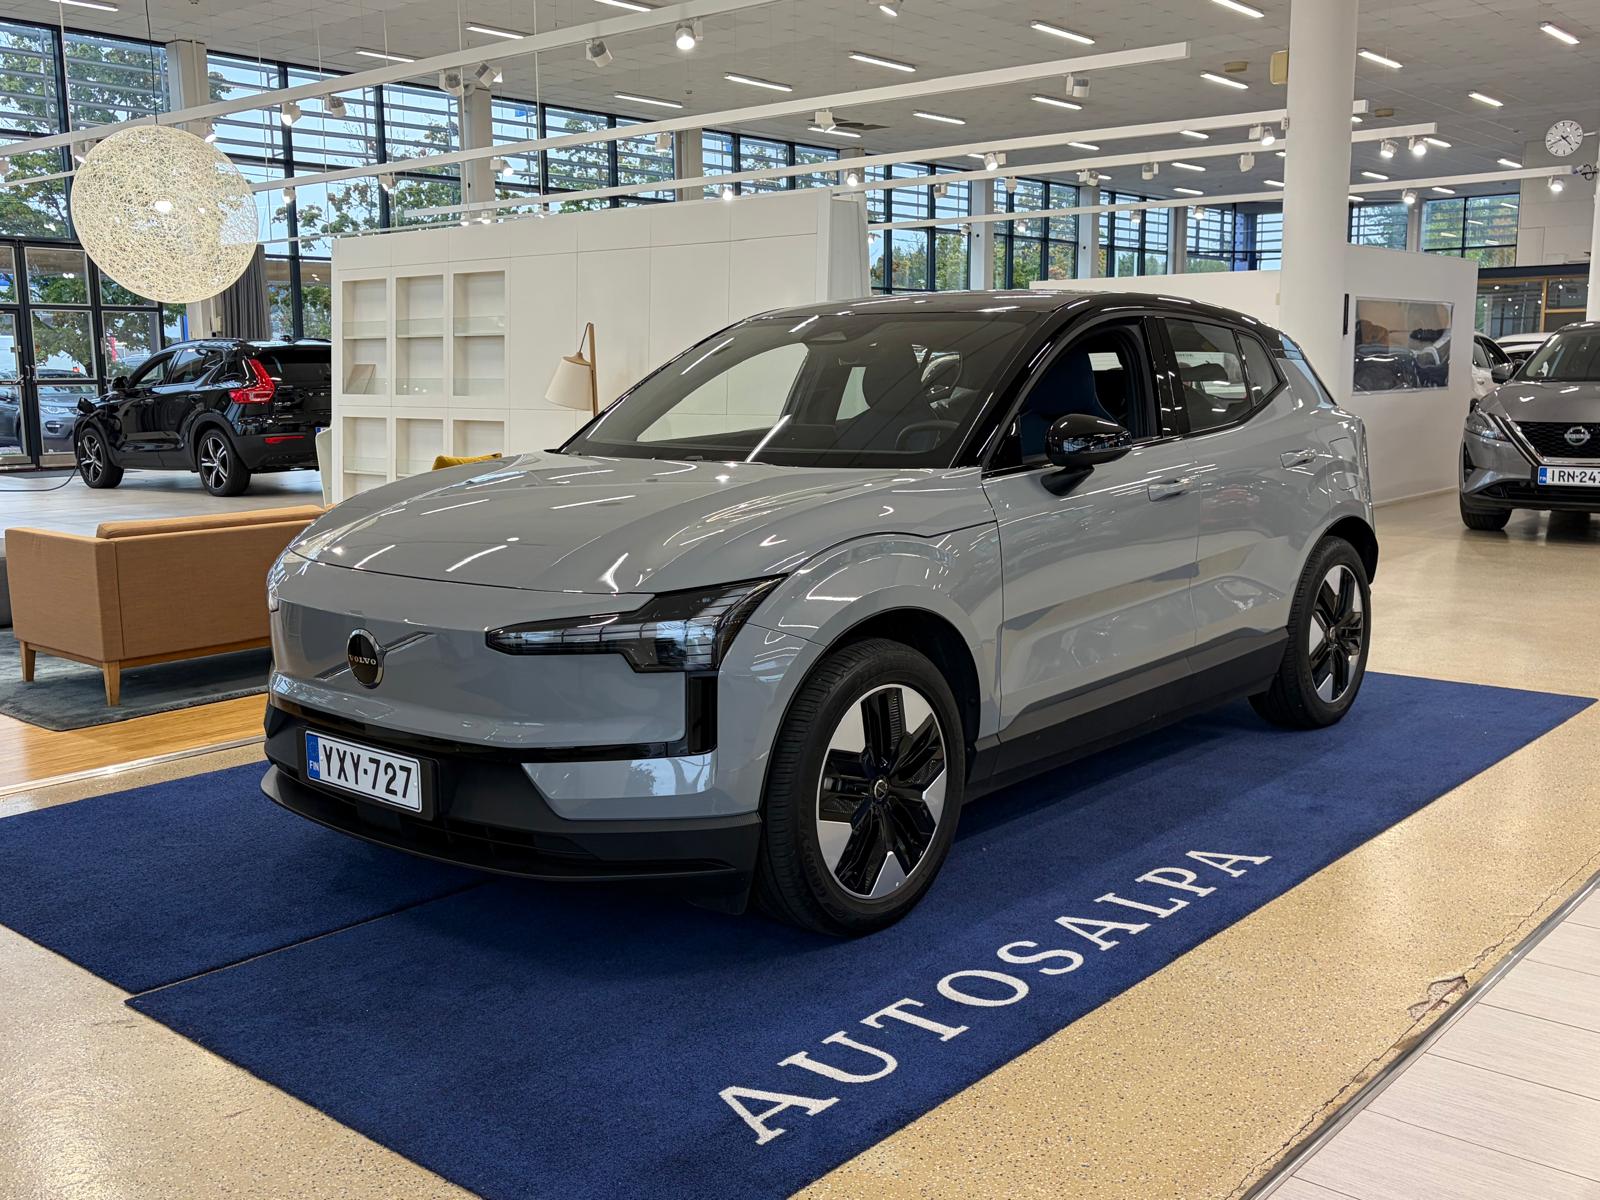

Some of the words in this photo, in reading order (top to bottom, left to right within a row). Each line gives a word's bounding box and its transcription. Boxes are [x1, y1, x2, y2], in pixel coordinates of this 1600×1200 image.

[1551, 469, 1600, 484] IRN-24
[348, 654, 377, 665] VOLVO
[322, 743, 412, 799] YXY-727
[718, 847, 1273, 1146] AUTOSALPA
